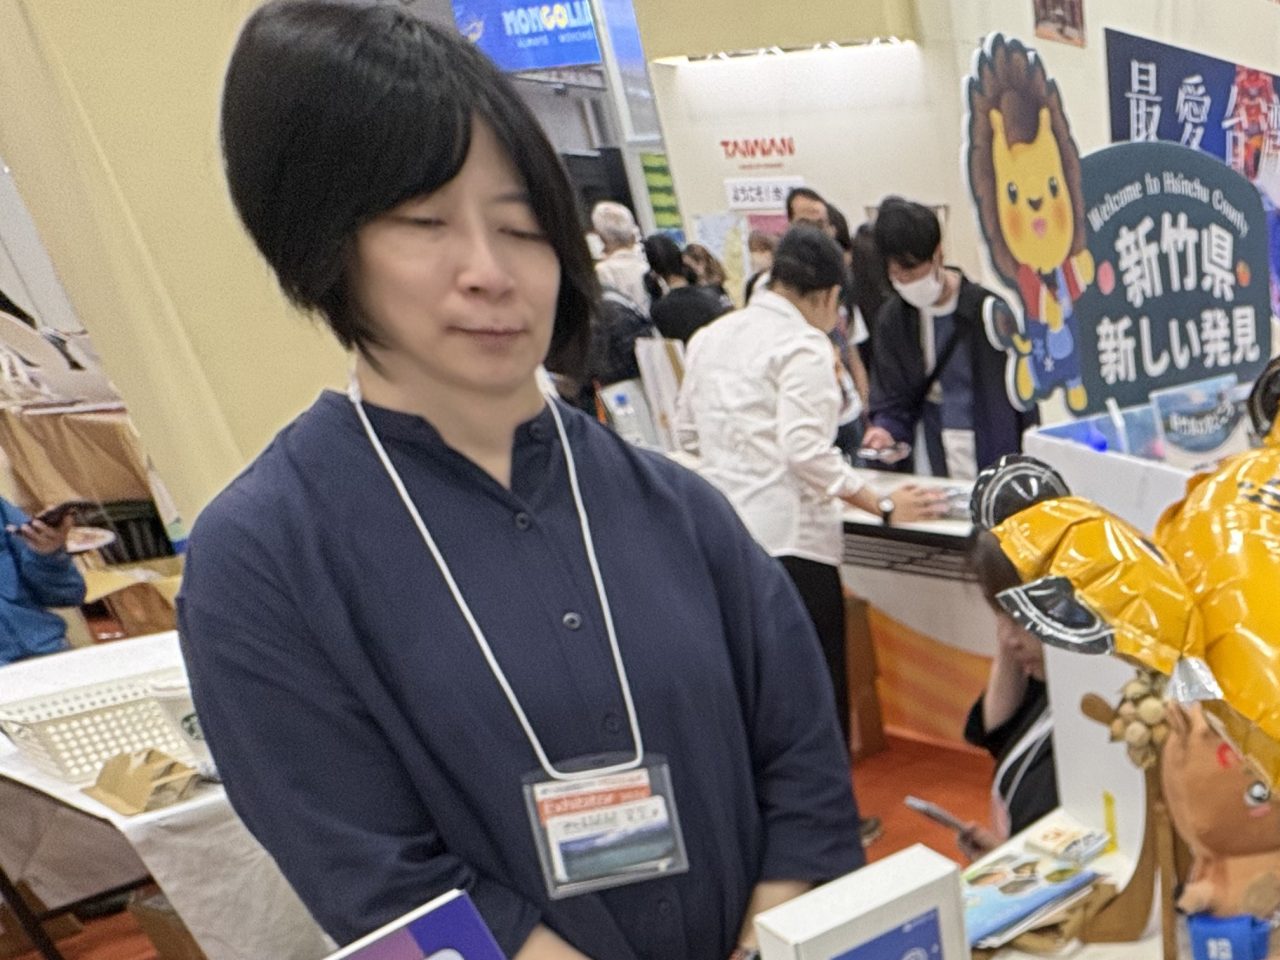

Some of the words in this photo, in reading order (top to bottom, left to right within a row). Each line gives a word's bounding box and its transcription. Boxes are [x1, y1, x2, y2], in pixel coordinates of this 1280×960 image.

[720, 137, 795, 158] TAIWAN
[1086, 180, 1143, 232] Welcome
[1144, 172, 1161, 195] to
[1162, 170, 1211, 204] Hsinchu
[1212, 188, 1251, 239] County
[1115, 211, 1236, 308] 新竹県
[1096, 304, 1260, 385] 新しい発見
